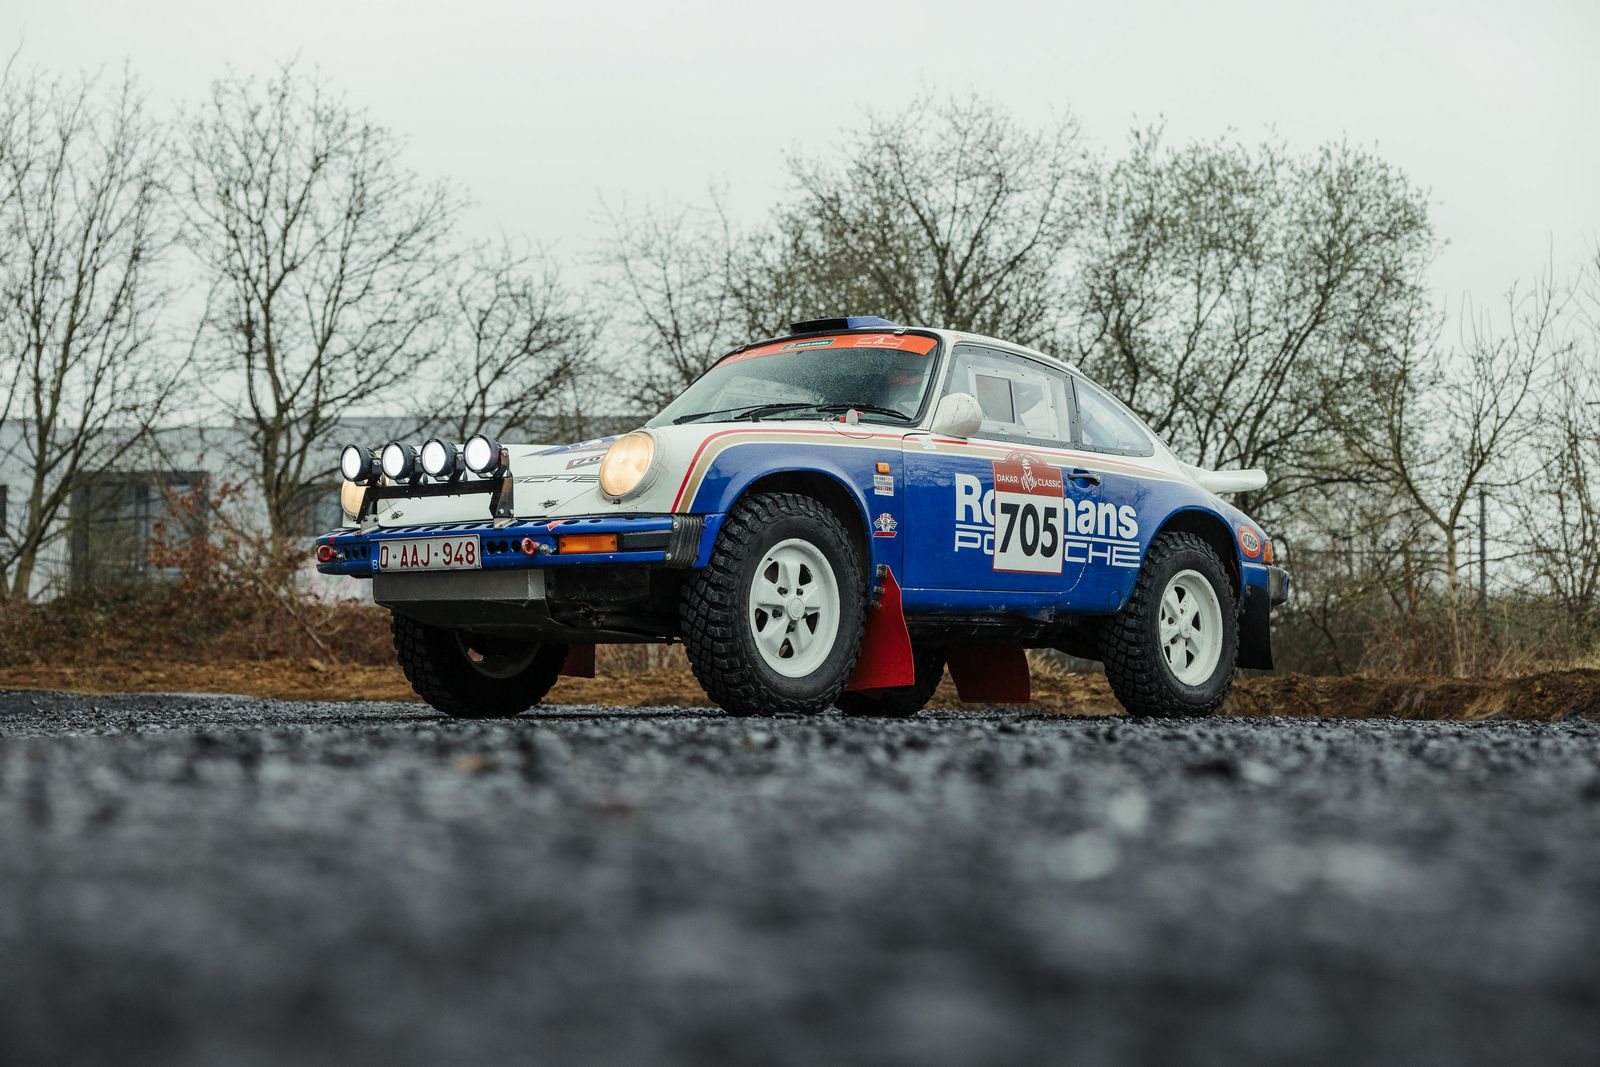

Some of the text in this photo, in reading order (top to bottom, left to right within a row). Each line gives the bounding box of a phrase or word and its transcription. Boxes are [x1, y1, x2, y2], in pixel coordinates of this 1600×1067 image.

[997, 474, 1062, 488] DAKAR CLASSIC
[954, 473, 1139, 539] Roans
[999, 502, 1058, 558] 705
[372, 560, 378, 569] B
[954, 531, 1140, 568] PCHE
